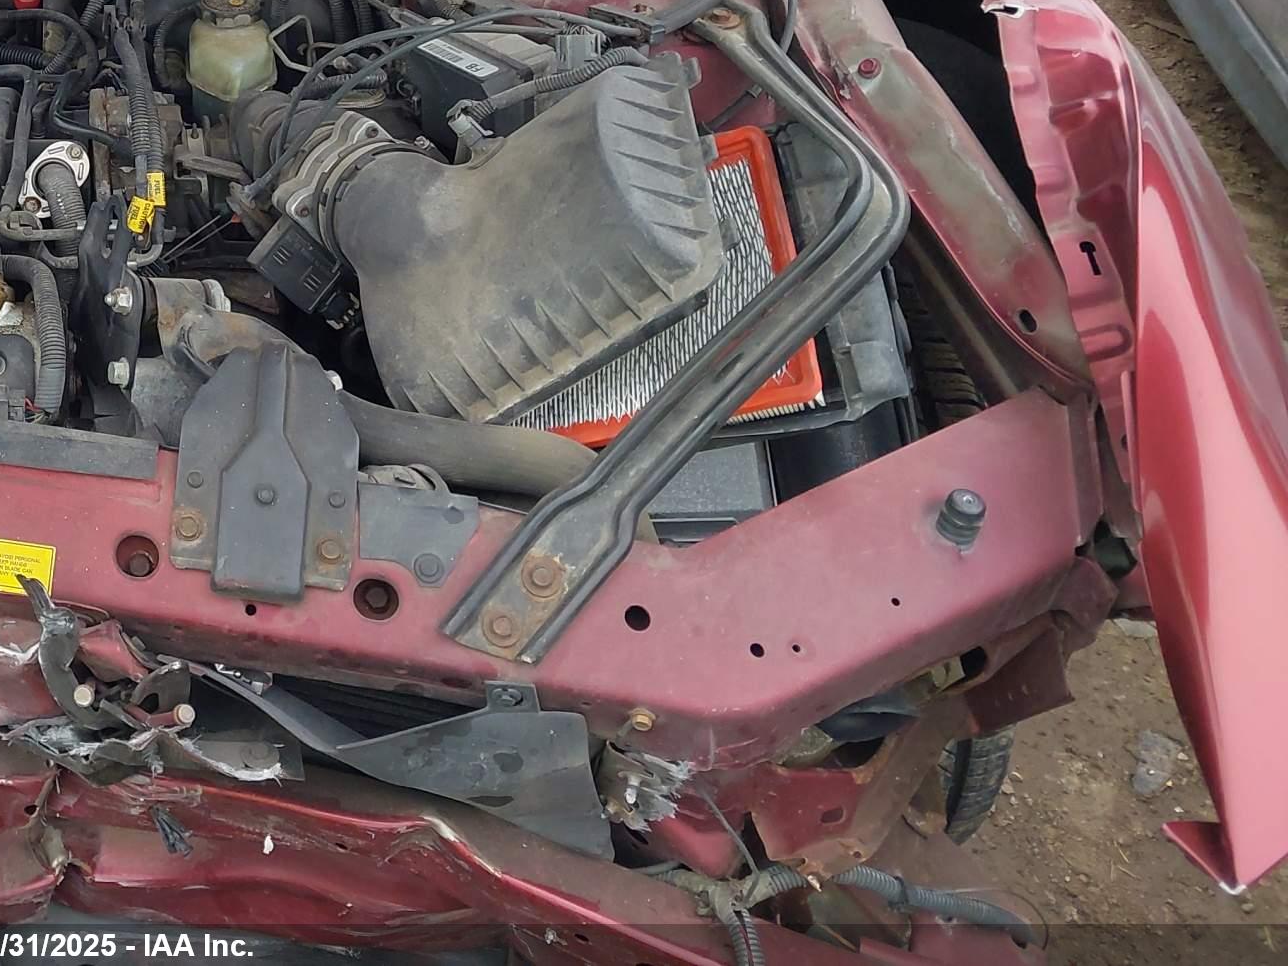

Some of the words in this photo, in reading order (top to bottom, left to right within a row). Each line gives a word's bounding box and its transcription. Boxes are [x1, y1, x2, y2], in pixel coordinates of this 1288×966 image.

[465, 63, 484, 72] FB
[130, 205, 140, 221] FUEL
[138, 203, 150, 229] CAUTION
